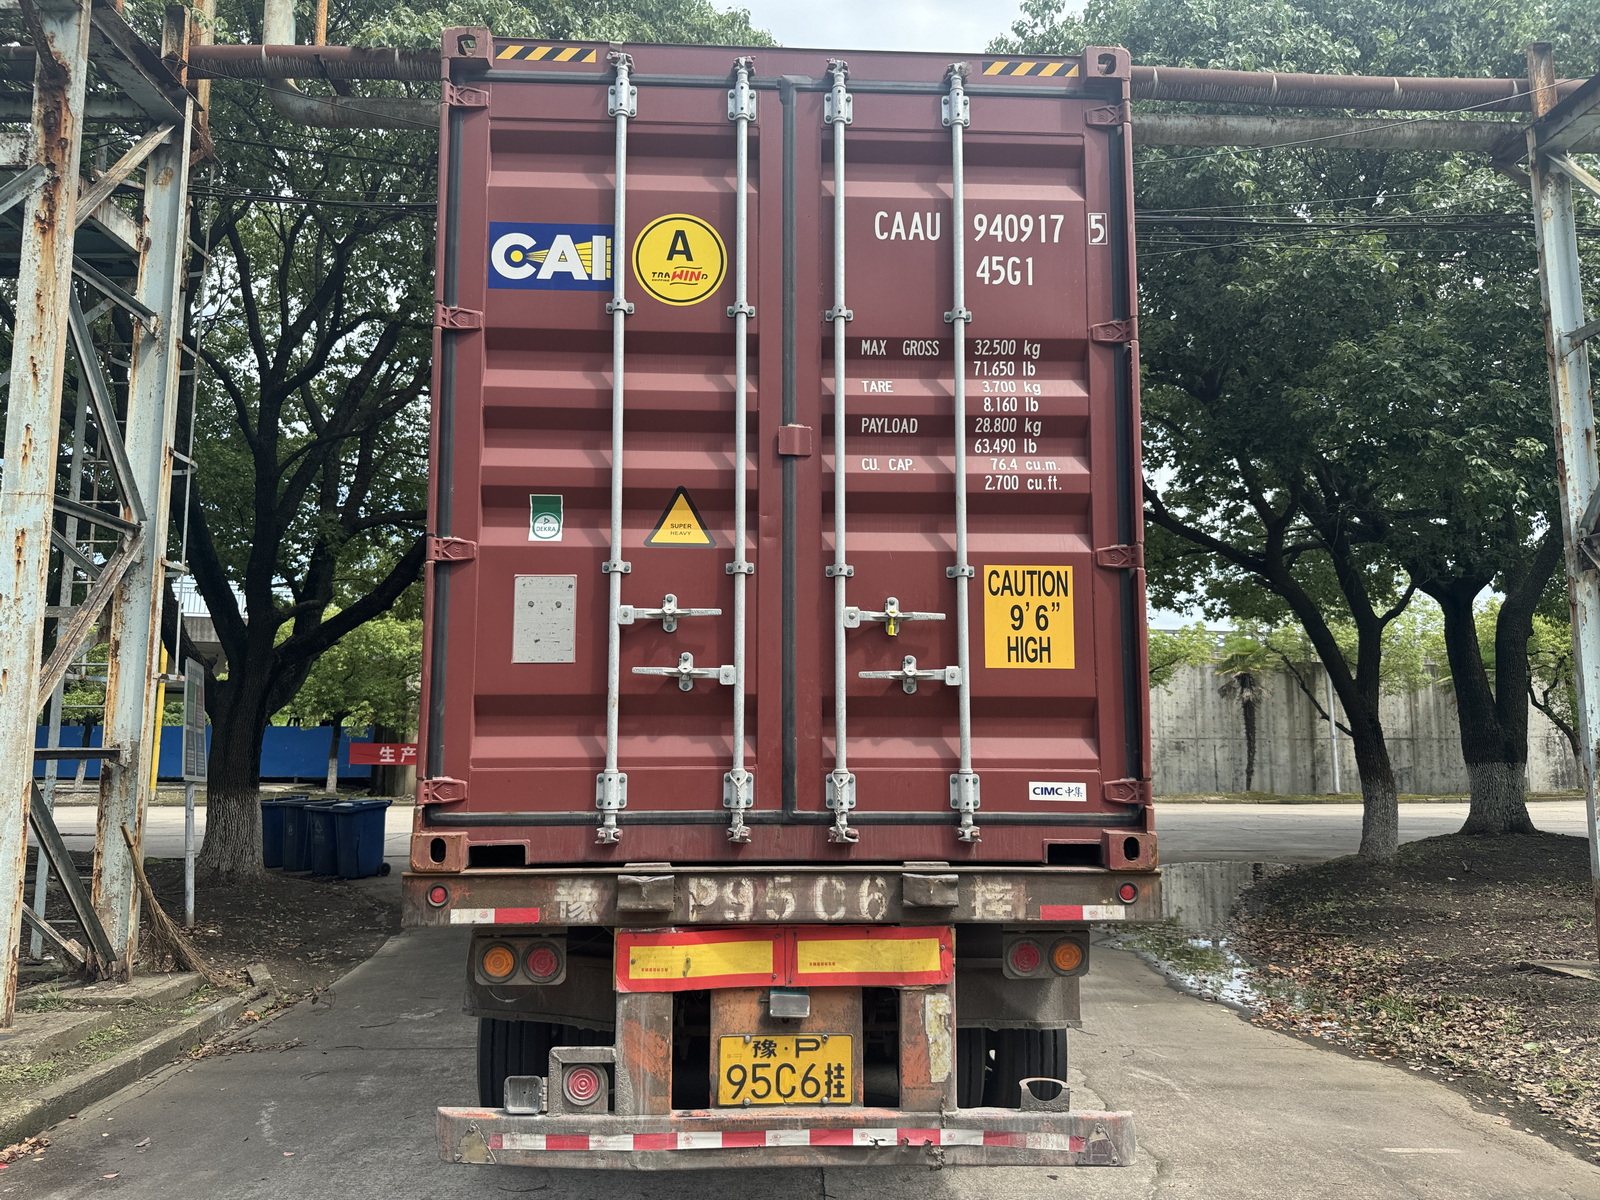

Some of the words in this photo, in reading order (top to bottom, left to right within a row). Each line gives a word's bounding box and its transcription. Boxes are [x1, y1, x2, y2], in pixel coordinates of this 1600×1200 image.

[874, 211, 941, 241] CAAU
[973, 213, 1065, 243] 940917
[1089, 215, 1106, 243] 5
[666, 229, 694, 262] A
[491, 232, 606, 281] CAI
[976, 255, 1034, 286] 45G1
[861, 340, 887, 356] MAX
[902, 340, 940, 357] GROSS
[1023, 340, 1041, 359] kg
[1022, 361, 1036, 377] lb
[861, 380, 894, 393] TARE
[1023, 381, 1042, 396] kg
[1025, 398, 1039, 412] lb
[861, 417, 918, 434] PAYLOAD
[1024, 419, 1042, 437] kg
[1023, 439, 1038, 454] lb
[861, 458, 880, 471] CU.
[888, 458, 917, 471] CAP.
[990, 458, 1018, 471] 76.4
[1025, 459, 1061, 471] cu.m.
[1027, 475, 1063, 491] cu.ft.
[987, 569, 1069, 598] CAUTION
[1007, 636, 1052, 664] HIGH
[379, 745, 417, 763] 生产
[1032, 786, 1063, 796] CIMC
[726, 1062, 846, 1100] 95C6挂
